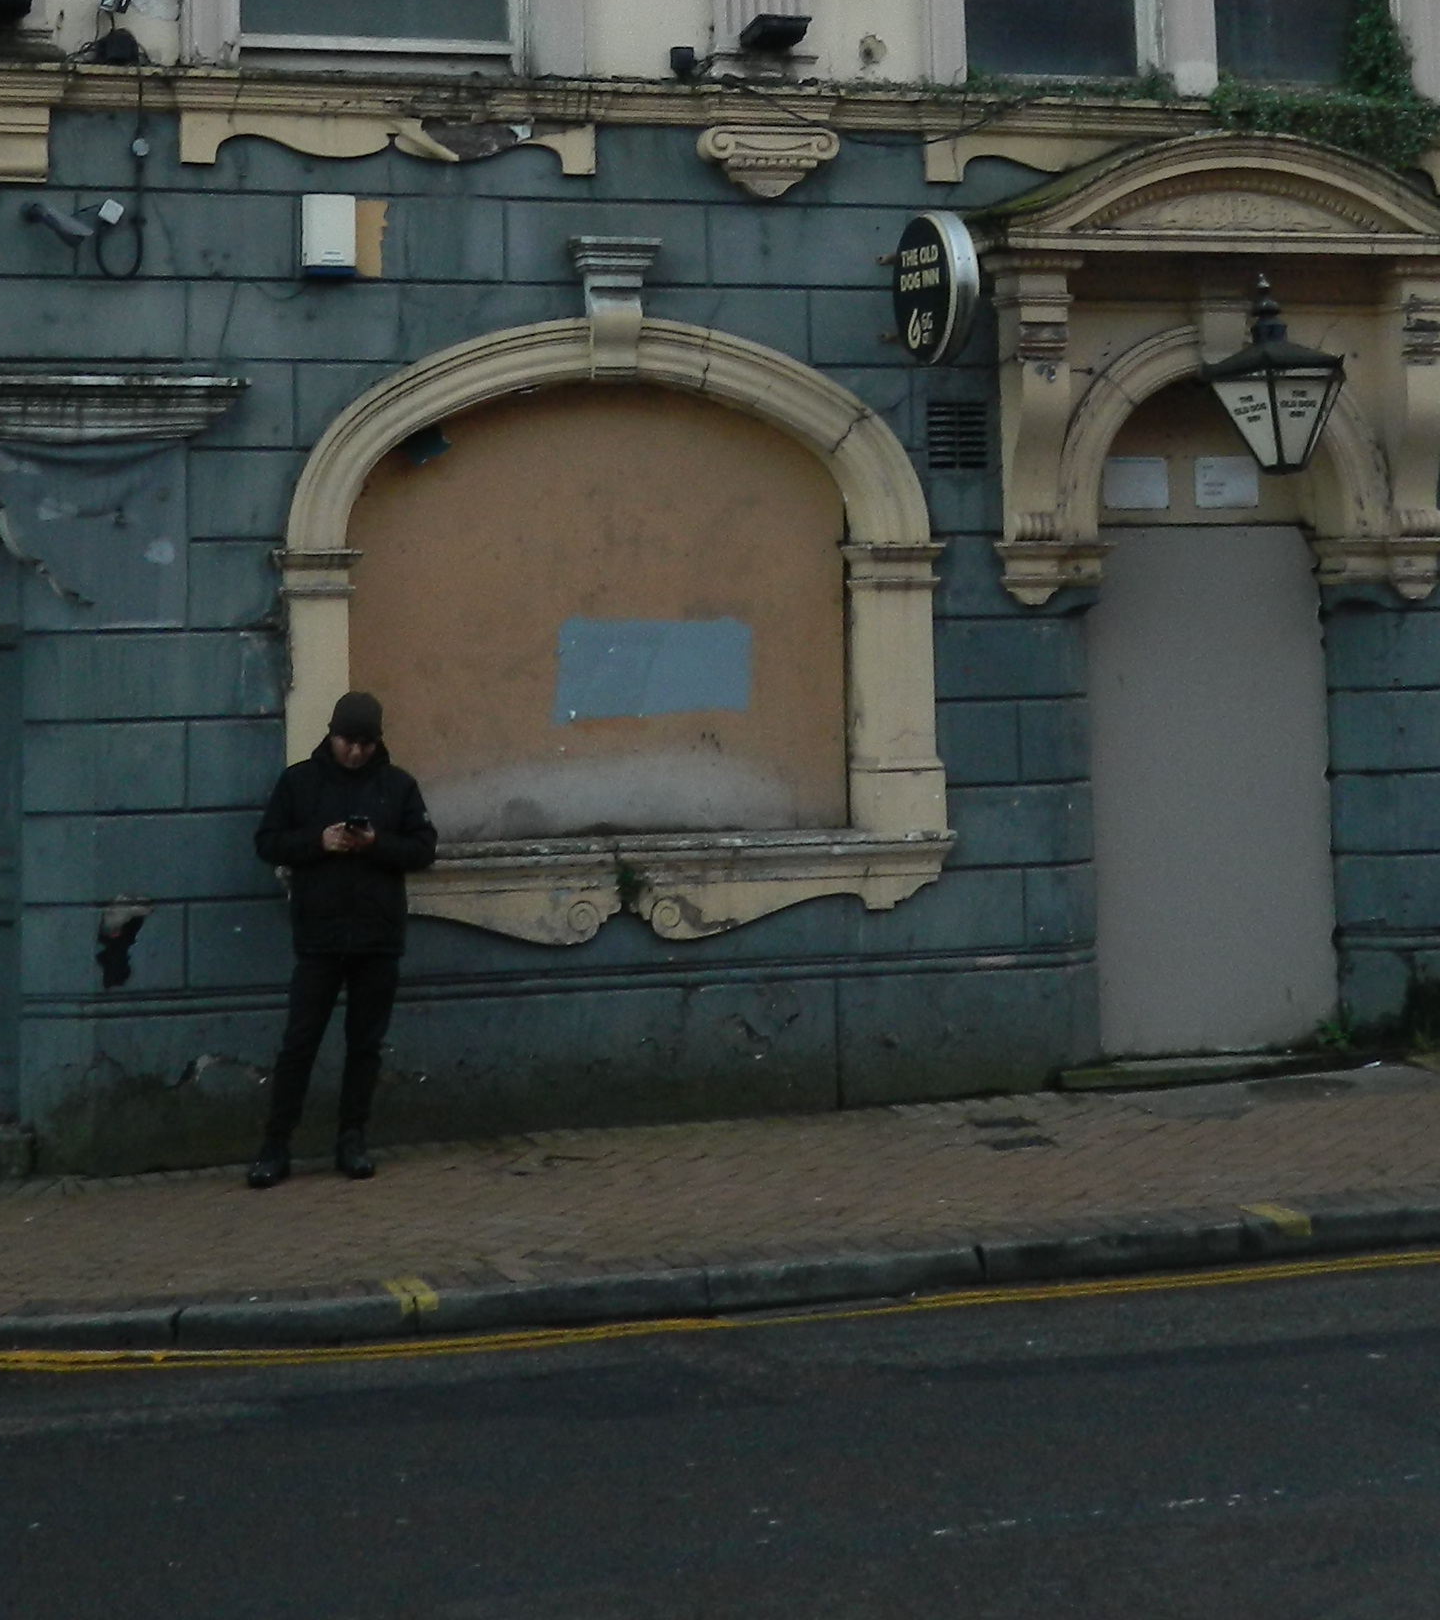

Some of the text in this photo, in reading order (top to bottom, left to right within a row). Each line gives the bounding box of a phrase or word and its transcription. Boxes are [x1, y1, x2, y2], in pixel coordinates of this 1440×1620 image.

[900, 244, 939, 268] THE OLD
[900, 267, 940, 292] DOG INN
